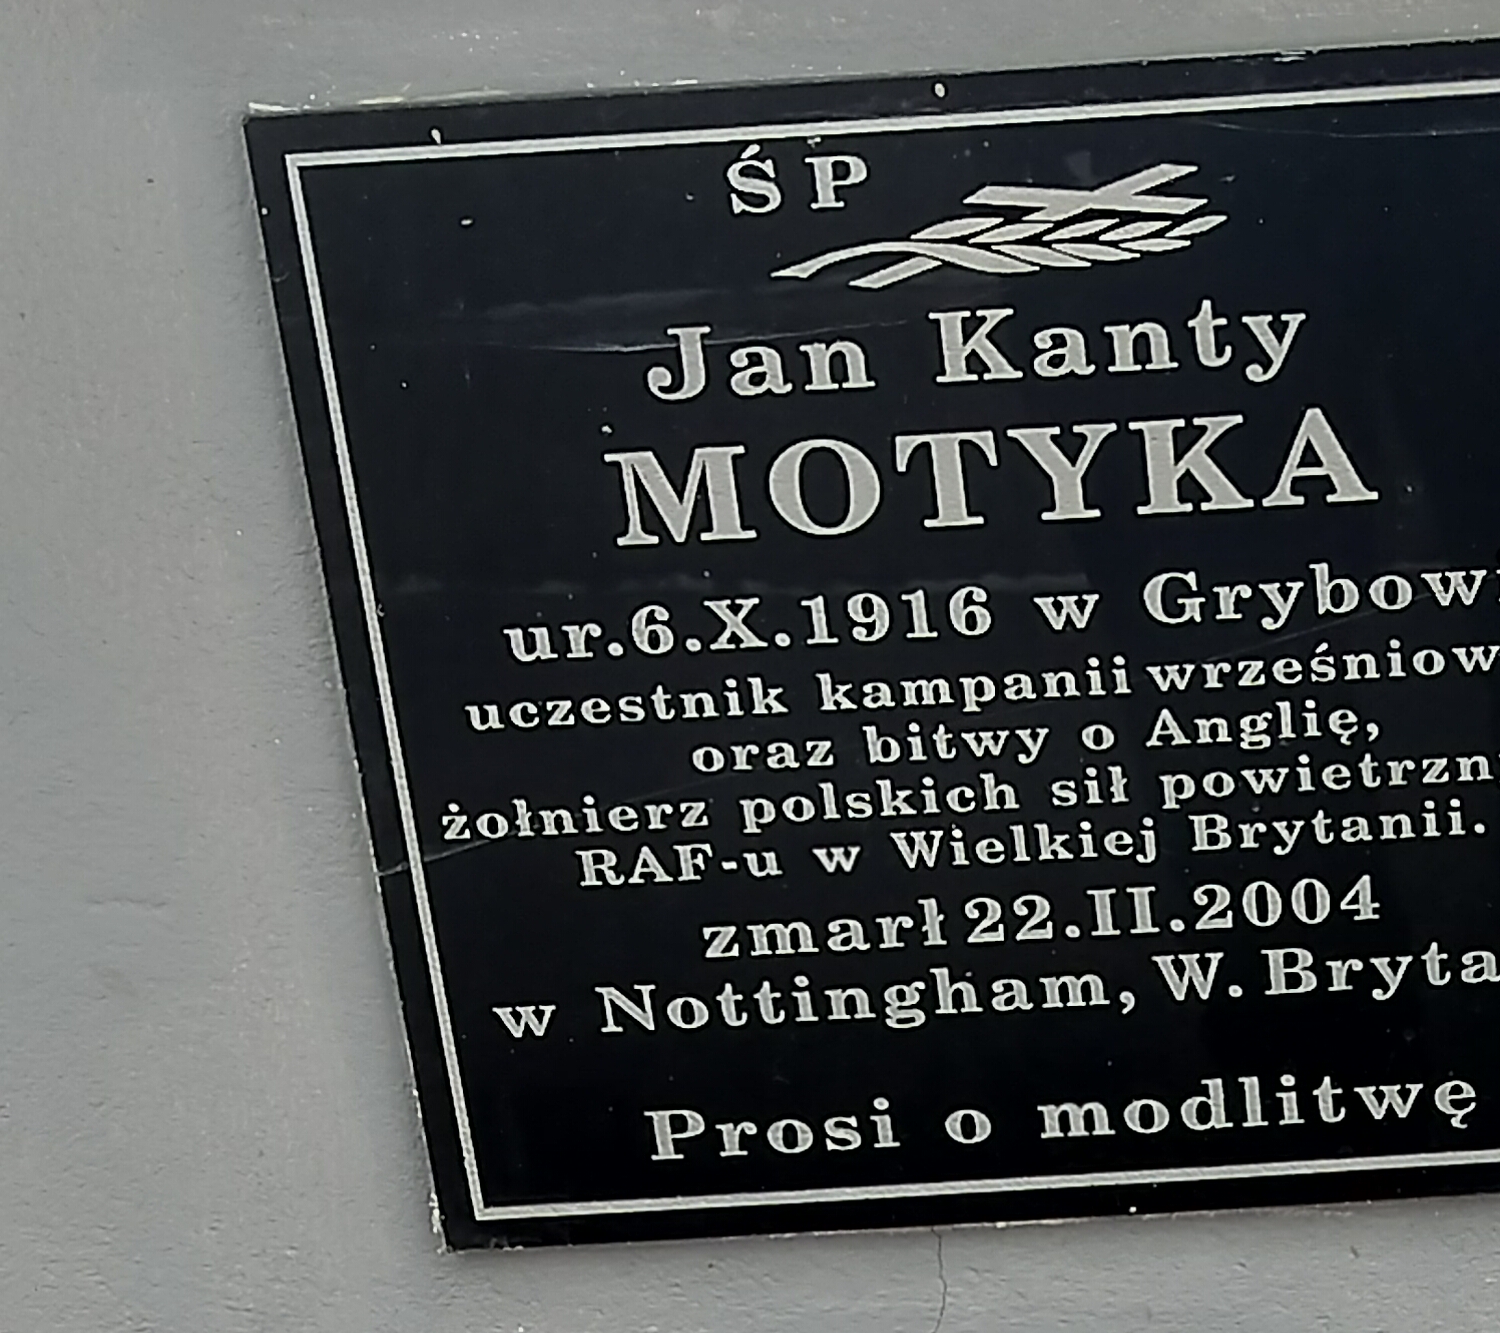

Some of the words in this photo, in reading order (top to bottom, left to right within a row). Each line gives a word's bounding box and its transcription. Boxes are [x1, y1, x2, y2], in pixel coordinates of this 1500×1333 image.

[648, 326, 875, 400] Jan
[929, 300, 1306, 382] Kanty
[604, 408, 1378, 546] MOTYKA
[1034, 594, 1099, 630] w
[465, 677, 788, 730] uczestnik
[816, 656, 1131, 710] kampanii
[693, 741, 833, 772] oraz
[863, 723, 1049, 764] bitwy
[1082, 725, 1114, 750] o
[1146, 700, 1378, 747] Anglię,
[442, 796, 708, 839] żołnierz
[740, 773, 1019, 833] polskich
[1052, 766, 1128, 806] sił
[575, 844, 782, 886] RAF-u
[813, 847, 860, 872] w
[890, 817, 1156, 868] Wielkiej
[1188, 799, 1485, 855] Brytanii.
[703, 898, 947, 957] zmarł
[965, 875, 1380, 943] 22.II.2004
[492, 1005, 556, 1037] w
[595, 968, 1135, 1032] Nottingham,
[1152, 952, 1242, 1000] W.
[644, 1098, 900, 1160] Prosi
[945, 1110, 991, 1143] o
[1037, 1075, 1476, 1138] modlitwę
